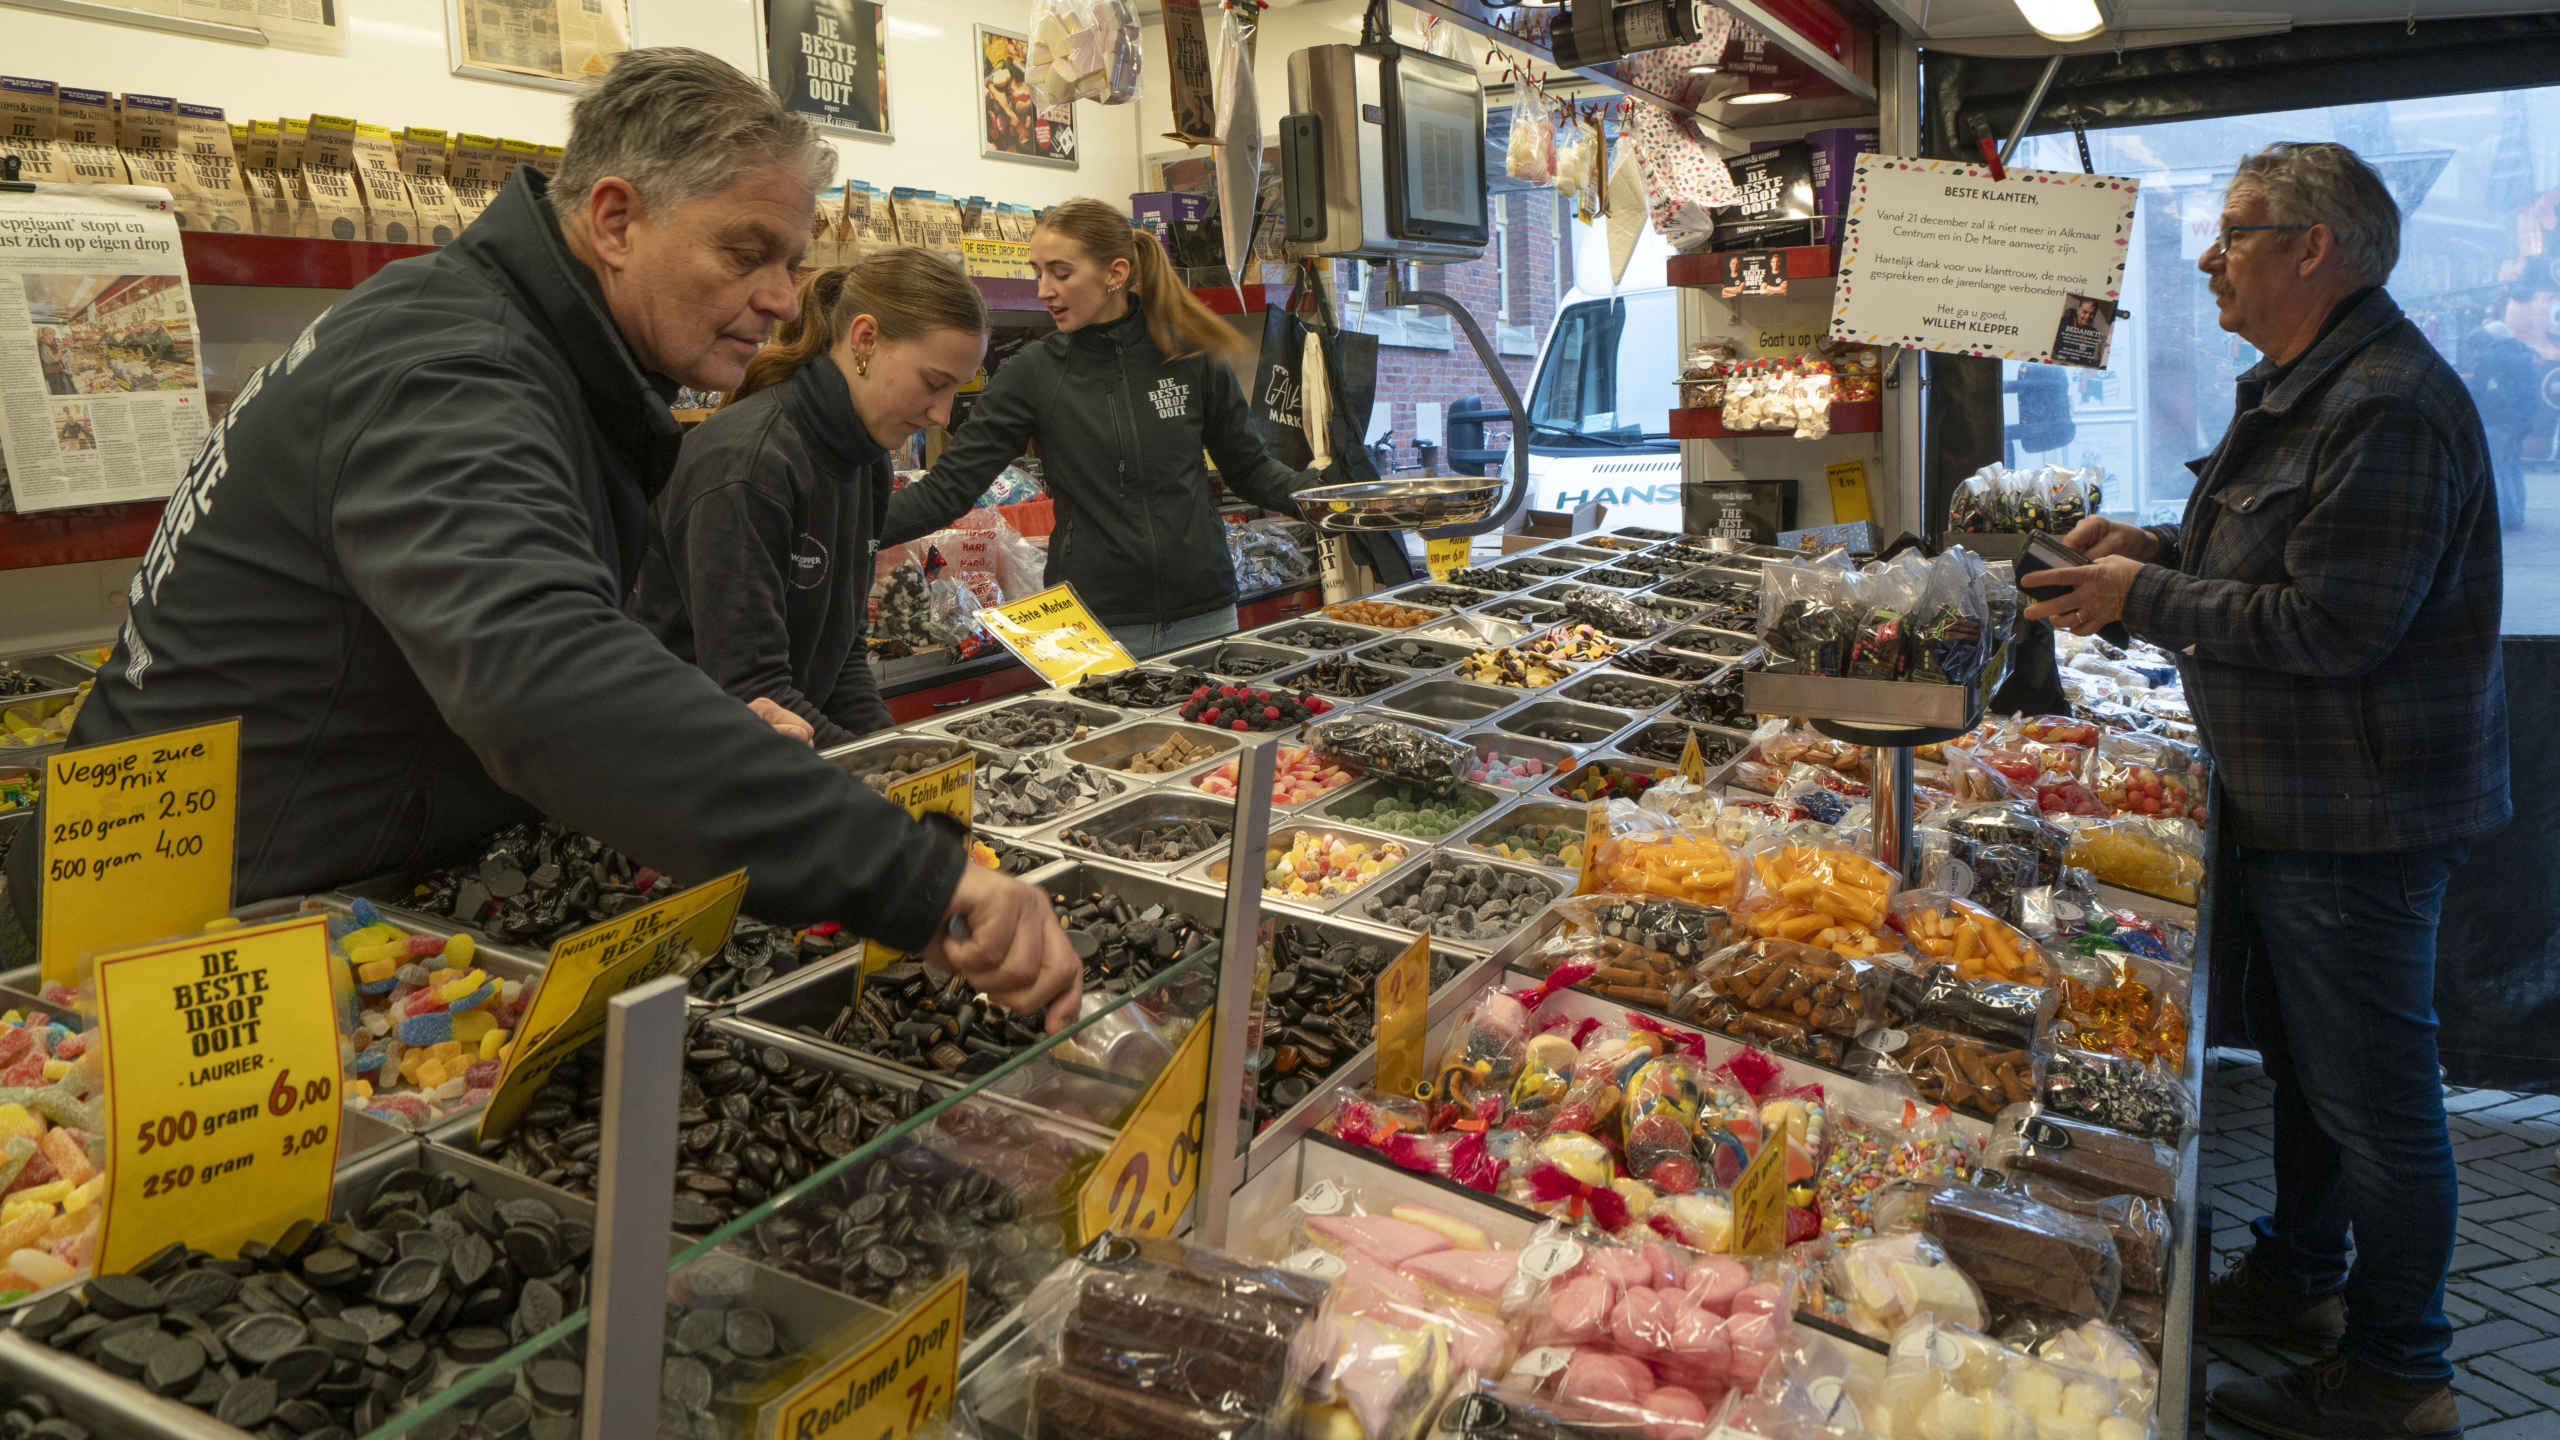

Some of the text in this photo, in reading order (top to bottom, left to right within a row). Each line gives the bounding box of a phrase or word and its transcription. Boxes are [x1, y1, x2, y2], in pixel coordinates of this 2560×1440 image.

[817, 15, 840, 41] DE
[1181, 22, 1194, 39] DE
[801, 31, 857, 66] BESTE
[1176, 37, 1204, 56] BESTE
[806, 55, 853, 85] DROP
[1177, 54, 1208, 73] KRAAM
[1183, 70, 1204, 88] OOIT
[809, 78, 852, 106] OOIT
[12, 124, 35, 137] DE
[74, 130, 96, 143] DE
[57, 141, 116, 156] BESTE
[140, 135, 161, 148] DE
[195, 142, 216, 154] DE
[69, 151, 111, 166] DROP
[123, 147, 179, 161] BESTE
[182, 153, 233, 168] BESTE
[319, 153, 337, 164] DE
[74, 164, 116, 178] OOIT
[135, 157, 177, 172] DROP
[193, 165, 230, 179] DROP
[305, 162, 348, 177] BESTE
[370, 159, 387, 170] DE
[416, 164, 431, 175] DE
[139, 169, 178, 183] OOIT
[310, 173, 348, 187] DROP
[362, 167, 400, 181] BESTE
[404, 174, 443, 186] BESTE
[464, 168, 479, 178] DE
[1746, 169, 1767, 183] DE
[197, 176, 231, 190] OOIT
[316, 183, 349, 197] OOIT
[370, 178, 400, 191] DROP
[413, 184, 444, 196] DROP
[452, 177, 488, 189] BESTE
[373, 188, 402, 201] OOIT
[418, 193, 445, 205] OOIT
[455, 187, 486, 199] DROP
[1739, 187, 1781, 206] DROP
[1944, 186, 2039, 206] BESTE KLANTEN,
[159, 201, 166, 211] 5
[459, 197, 488, 208] OOIT
[1740, 198, 1779, 216] OOIT
[0, 217, 145, 235] epgigant’ stopt en
[1877, 209, 2102, 241] Vanaf 21 december zal ik niet meer in Alkmaar
[25, 234, 61, 248] zich
[64, 237, 85, 251] op
[89, 235, 131, 252] eigen
[134, 237, 170, 253] drop
[1893, 226, 2078, 256] Centrum en in De Mare aanwezig zijn.
[965, 243, 1031, 257] DE BESTE DROP OOIT
[1874, 253, 2088, 284] Hartelijk dank voor uw klanttrouw, de mooie
[1869, 270, 1925, 282] gesprekken
[1926, 276, 1939, 284] en
[1941, 275, 1954, 285] de
[1955, 277, 2006, 293] jarenlange
[1937, 304, 1954, 315] Het
[1956, 309, 1969, 318] ga
[1980, 311, 2008, 321] goed,
[1922, 316, 2019, 336] WILLEM KLEPPER
[1760, 331, 1811, 348] Gaat u op
[1157, 377, 1176, 389] DE
[1148, 384, 1190, 401] BESTE
[1153, 395, 1187, 410] DROP
[1158, 405, 1186, 419] OOIT
[1269, 408, 1302, 428] MARK
[1721, 508, 1742, 518] THE
[1718, 518, 1743, 528] BEST
[1430, 552, 1451, 564] 500 gram
[1007, 598, 1074, 626] Echte Merken
[57, 743, 206, 788] Veggie zure
[120, 769, 168, 792] mix
[909, 782, 938, 807] Echte
[940, 769, 970, 797] Merken
[53, 819, 93, 845] 250
[97, 813, 146, 841] gram
[50, 857, 87, 882] 500
[93, 852, 142, 882] gram
[560, 910, 664, 959] NIEUW: DE
[652, 931, 682, 959] DE
[200, 949, 239, 979] DE
[172, 969, 269, 1010] BESTE
[184, 995, 265, 1034] DROP
[191, 1020, 262, 1057] OOIT
[189, 1054, 264, 1087] LAURIER
[138, 1069, 331, 1155] 500 gram 6,00
[143, 1125, 328, 1199] 250 gram 3,00
[796, 1318, 950, 1440] Reclame Drop
